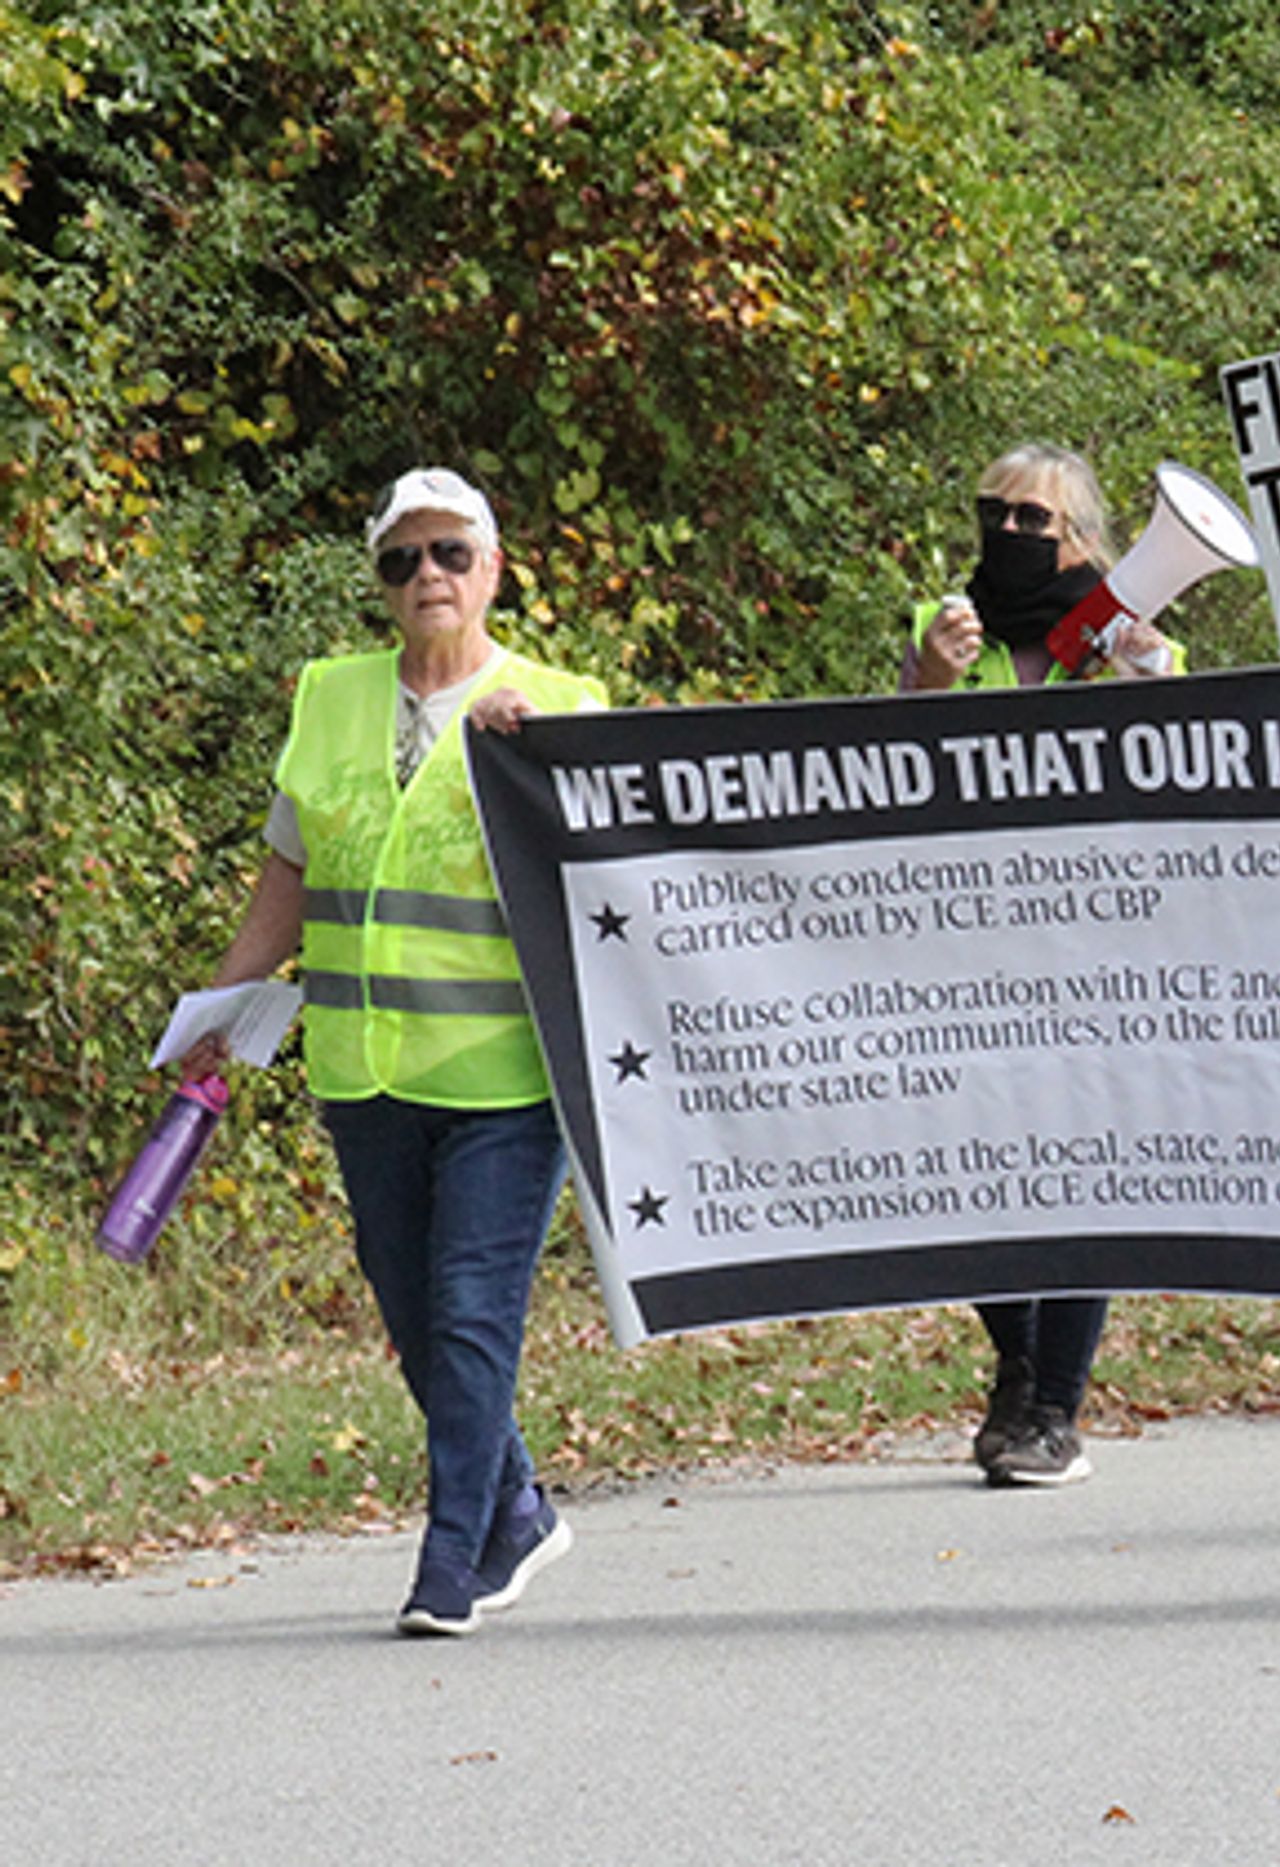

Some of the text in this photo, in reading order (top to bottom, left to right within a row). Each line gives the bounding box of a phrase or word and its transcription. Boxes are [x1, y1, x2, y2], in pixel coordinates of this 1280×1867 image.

[551, 763, 655, 832] WE
[658, 741, 935, 825] DEMAND
[941, 728, 1107, 802] THAT
[1120, 719, 1254, 792] OUR
[652, 868, 799, 915] Publicly
[810, 861, 993, 901] condemn
[1004, 845, 1145, 886] abusive
[1156, 844, 1223, 880] and
[655, 888, 1162, 957] carried out by ICE and CBP
[667, 996, 793, 1037] Refuse
[804, 970, 1058, 1024] collaboration
[1065, 965, 1148, 1002] with
[1158, 964, 1220, 1001] ICE
[670, 1039, 771, 1075] harm
[779, 1034, 847, 1068] our
[855, 1010, 1113, 1060] communities,
[1119, 1012, 1157, 1043] to
[1166, 1006, 1224, 1042] the
[679, 1062, 963, 1116] under state law
[688, 1156, 779, 1195] Take
[787, 1147, 905, 1186] action
[916, 1145, 949, 1178] at
[958, 1137, 1019, 1174] the
[1027, 1129, 1131, 1169] local,
[1136, 1132, 1228, 1167] state,
[693, 1200, 756, 1238] the
[765, 1182, 962, 1231] expansion
[971, 1175, 1009, 1212] of
[1018, 1173, 1085, 1210] ICE
[1093, 1170, 1268, 1206] detention
